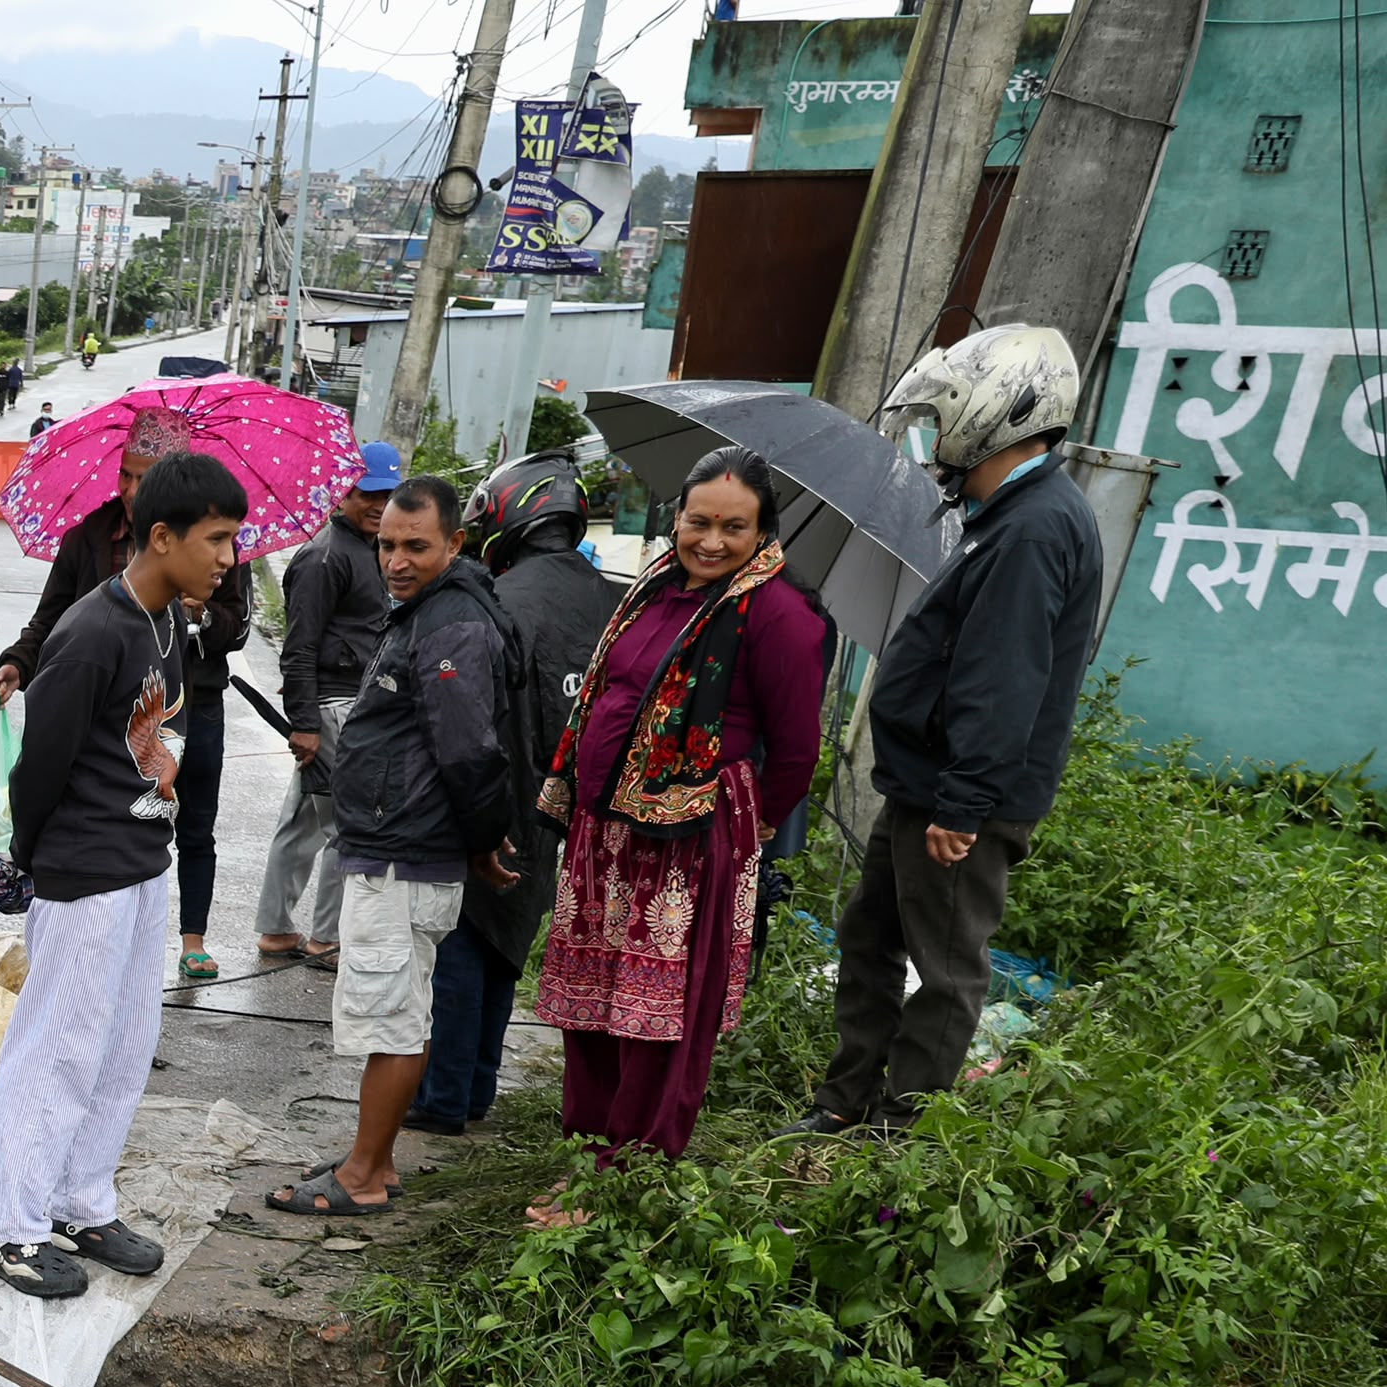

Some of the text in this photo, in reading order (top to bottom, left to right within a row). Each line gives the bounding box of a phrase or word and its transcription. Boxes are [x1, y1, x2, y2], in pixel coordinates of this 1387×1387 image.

[782, 80, 902, 113] शुभारम्भ
[521, 114, 549, 136] XI
[520, 138, 555, 160] XII
